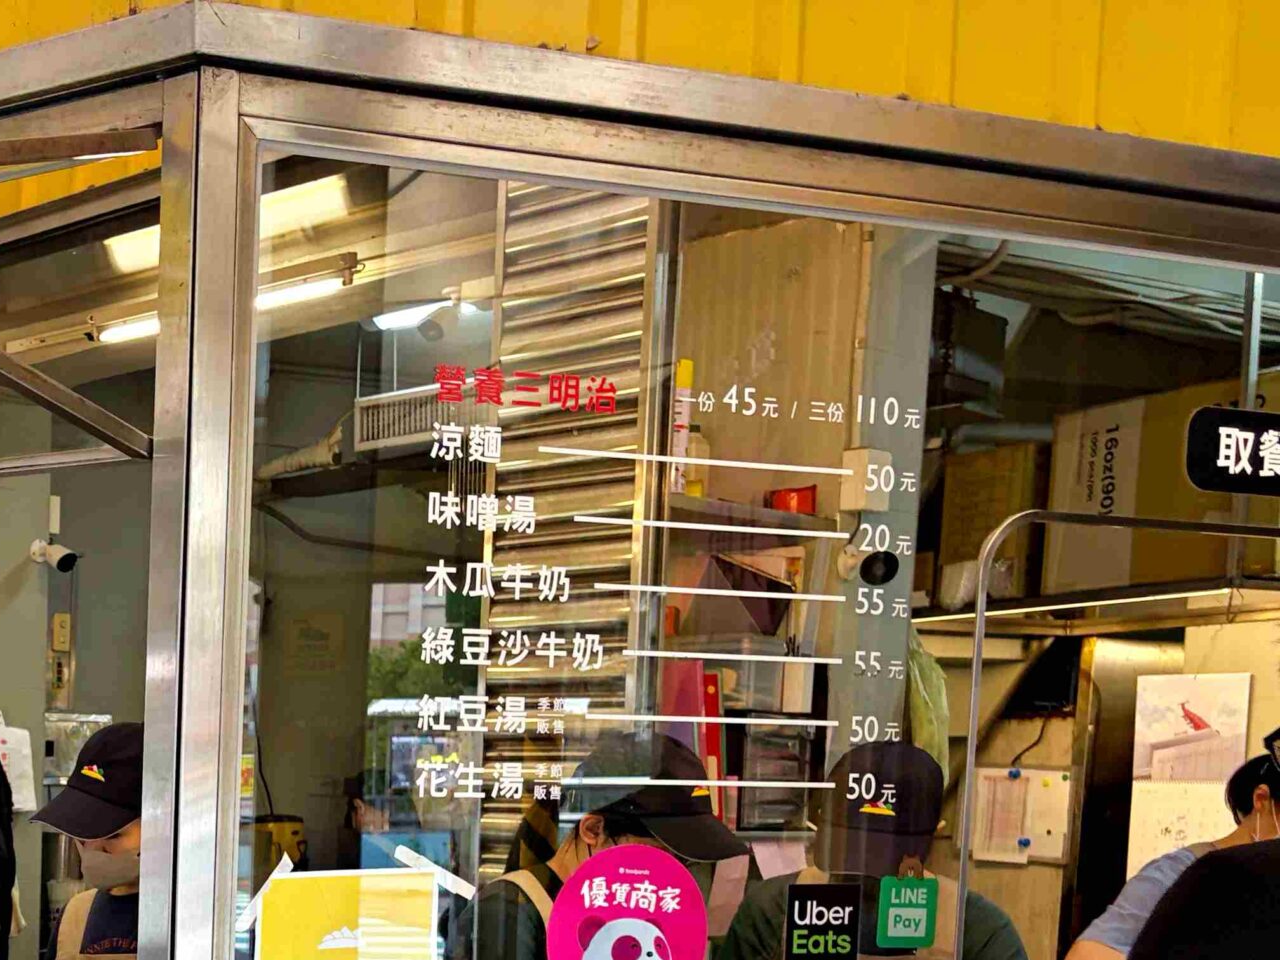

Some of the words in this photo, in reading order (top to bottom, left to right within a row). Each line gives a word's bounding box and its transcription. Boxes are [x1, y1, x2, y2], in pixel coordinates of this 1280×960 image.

[434, 364, 617, 414] 營養三明治
[430, 421, 503, 464] 涼麵
[1216, 425, 1280, 478] 取餐
[427, 491, 537, 534] 味噌湯
[423, 558, 571, 603] 木瓜牛奶
[420, 626, 604, 672] 綠豆沙牛奶
[417, 693, 528, 734] 紅豆湯
[415, 761, 524, 800] 花生湯
[580, 876, 681, 913] 優質商家
[793, 899, 854, 926] Uber
[890, 887, 928, 904] LINE
[792, 929, 852, 954] Eats
[893, 914, 922, 933] Pay
